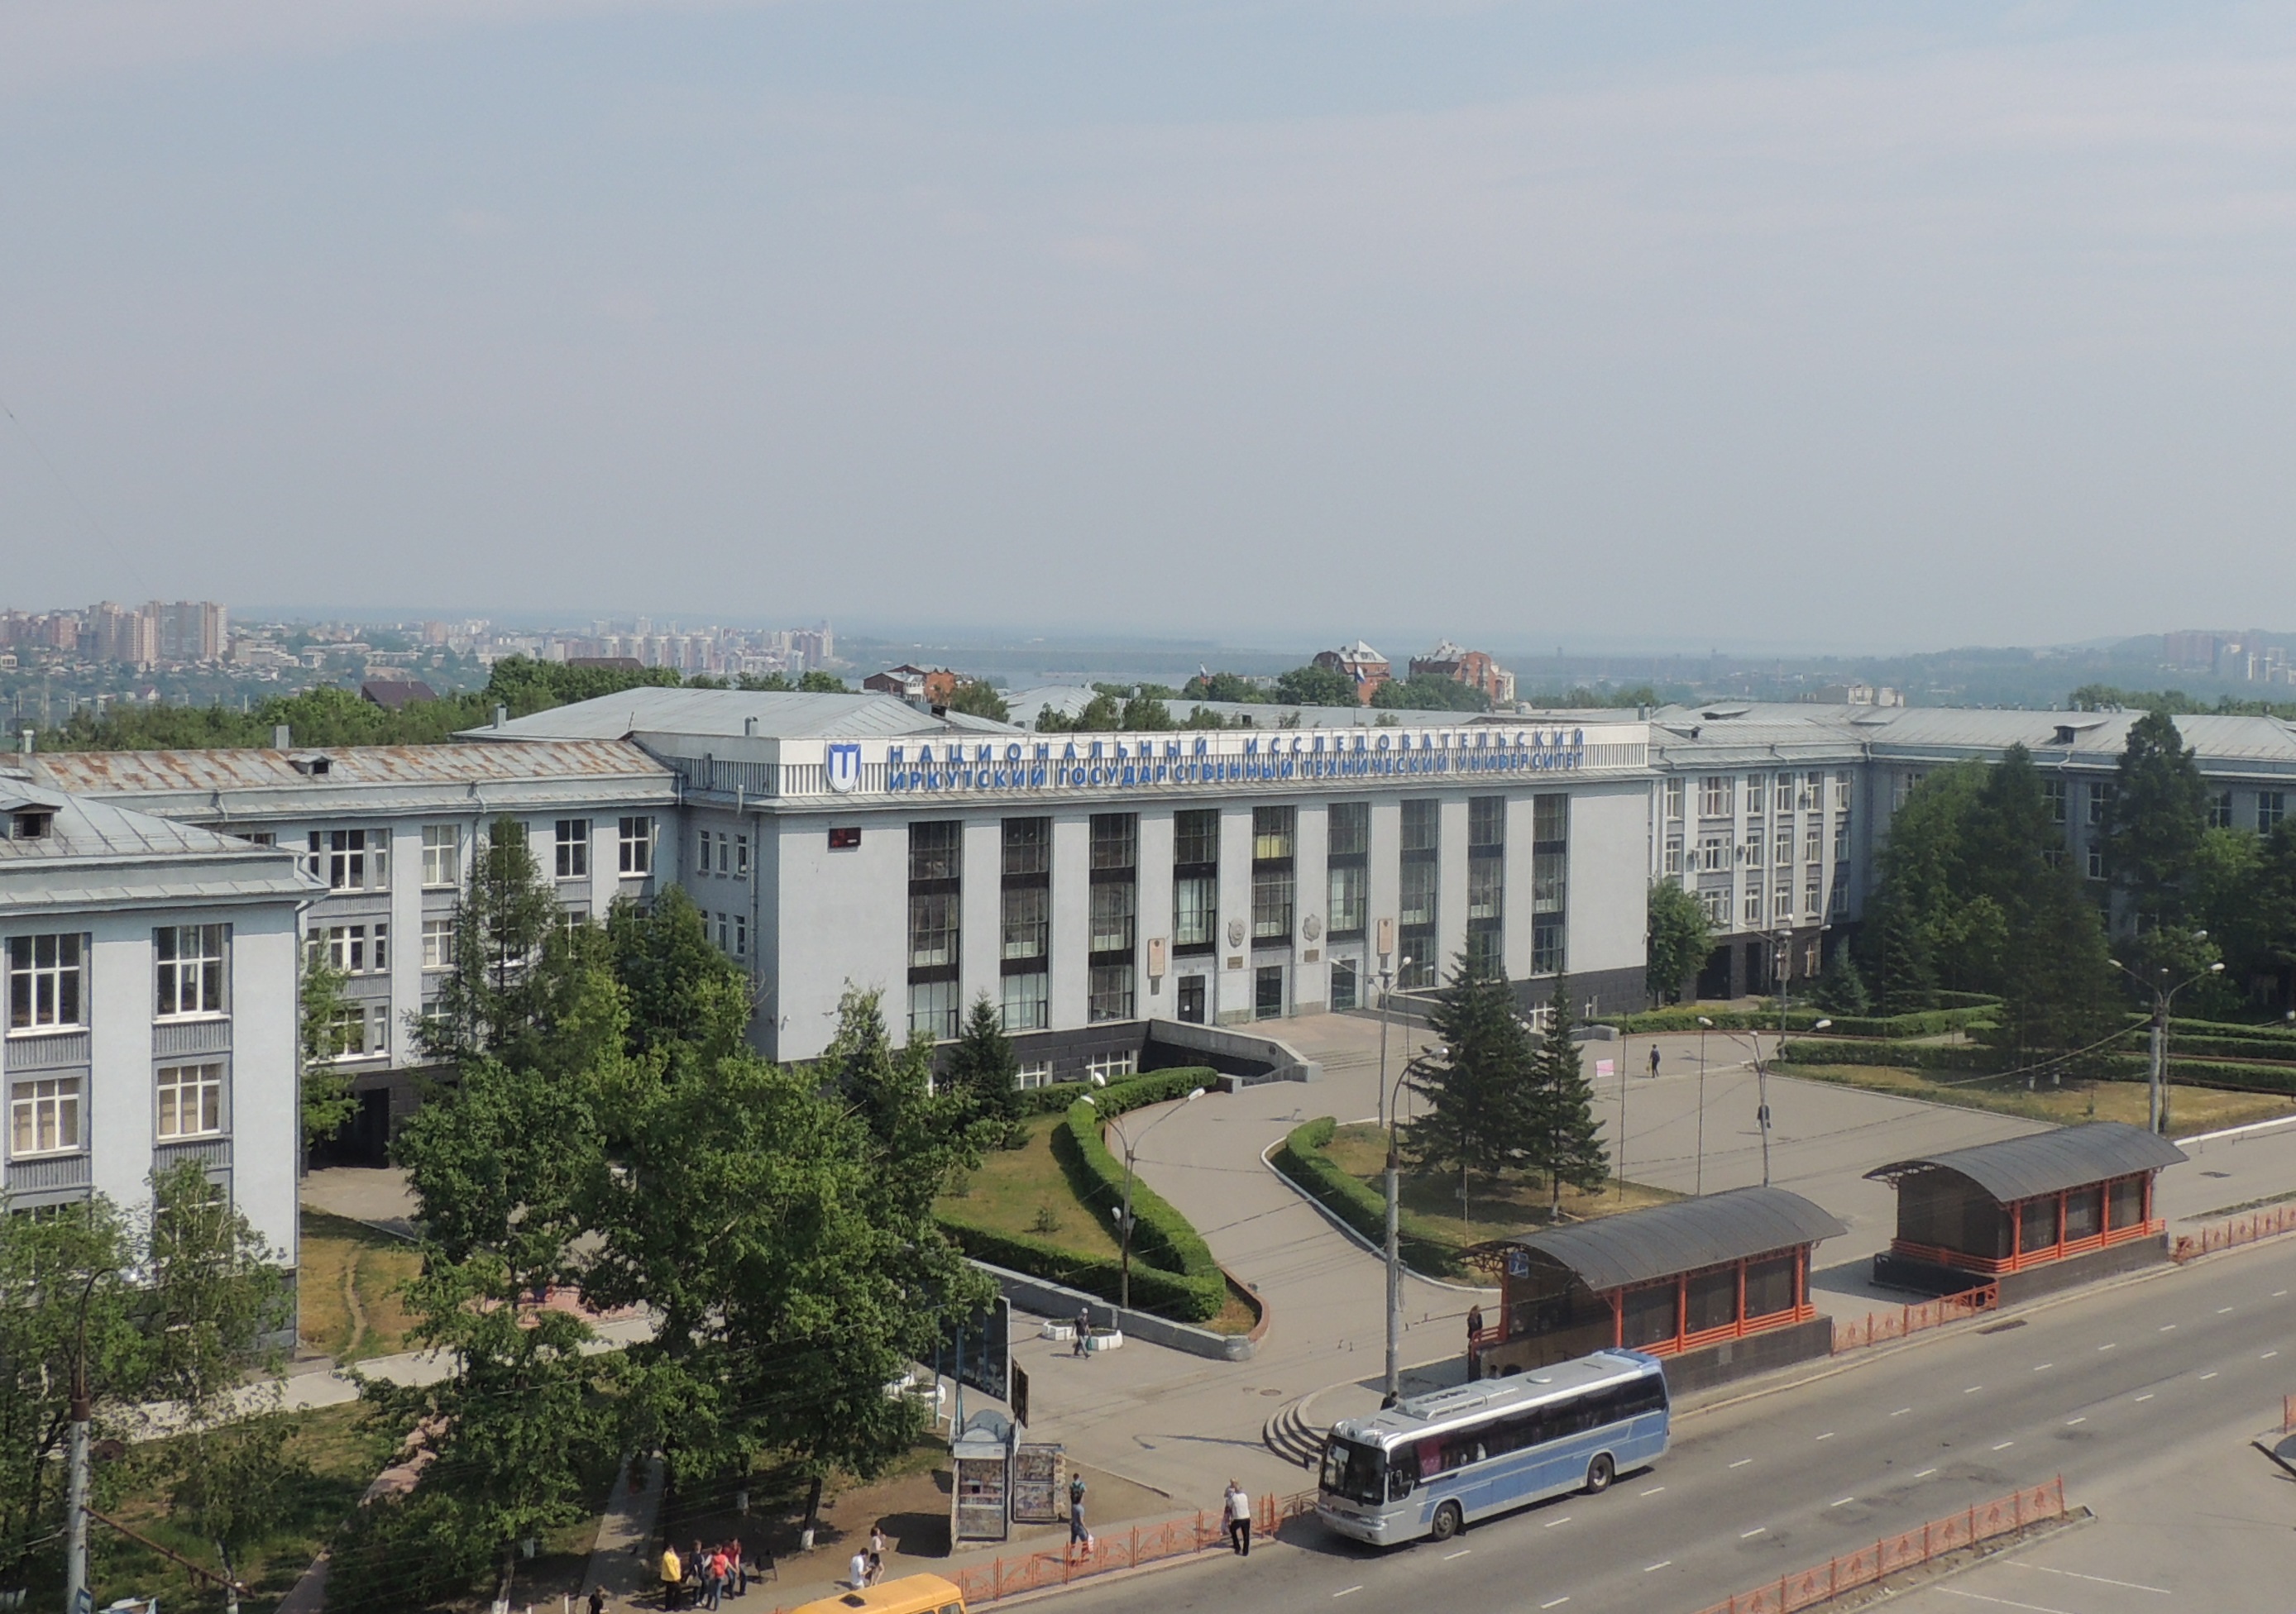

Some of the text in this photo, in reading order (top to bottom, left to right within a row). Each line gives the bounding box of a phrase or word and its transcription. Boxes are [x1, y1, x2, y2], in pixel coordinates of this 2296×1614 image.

[889, 728, 1584, 764] НАЦИОНАЛЬНЫЙ ИССЛЕДОВАТЕЛЬСКИЙ
[889, 752, 1584, 790] ИРКУТСКИЙ ГОСУДАРСТВЕННЫЙ ТЕХНИЧЕСКИЙ УНИВЕРСИТЕТ
